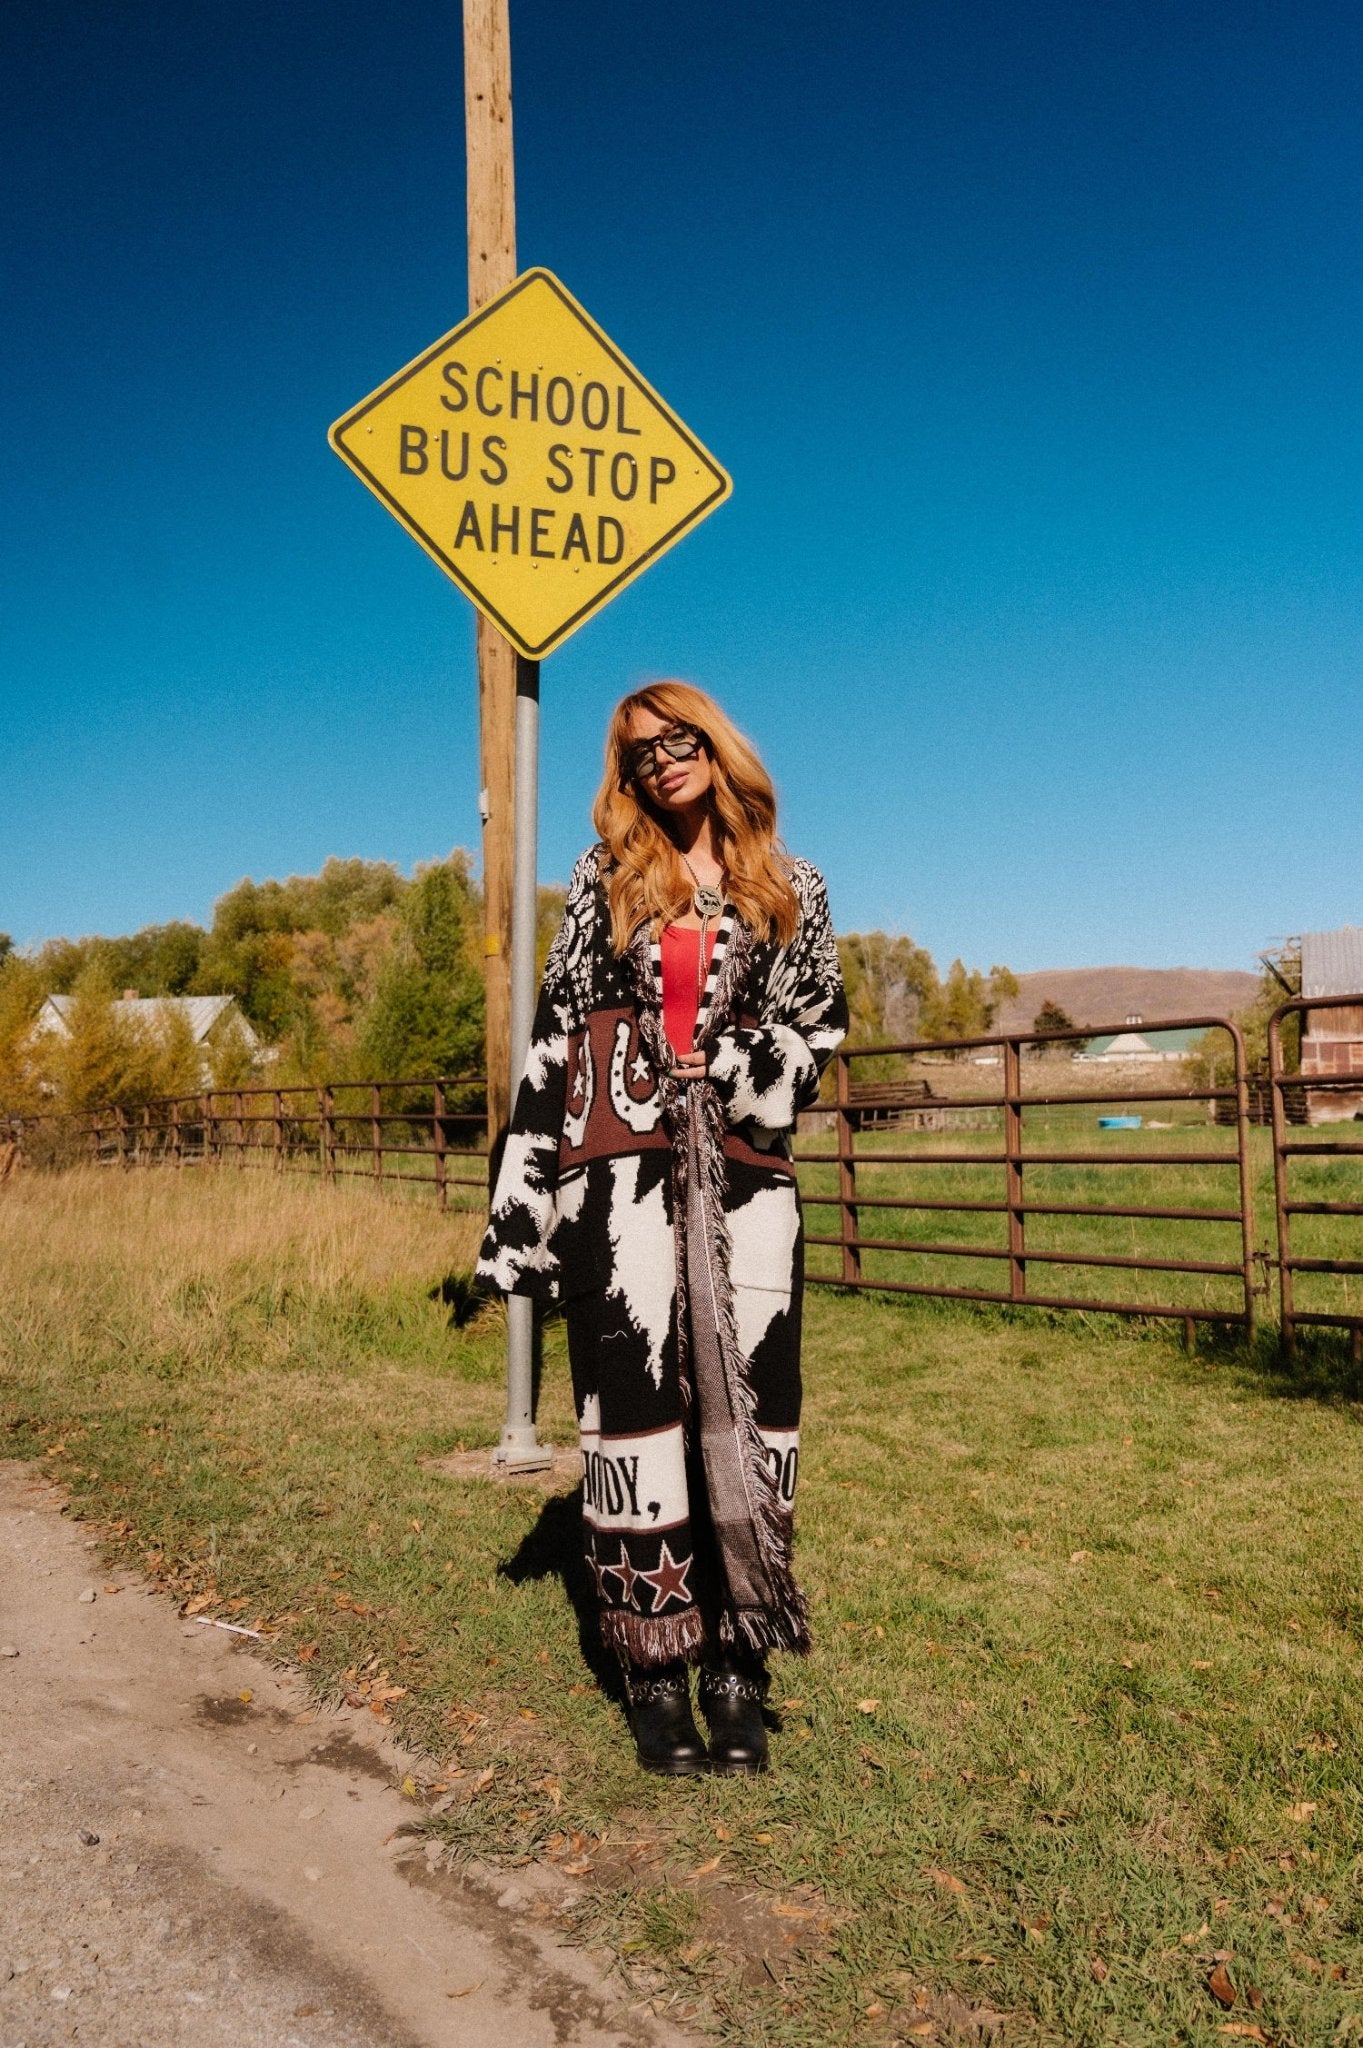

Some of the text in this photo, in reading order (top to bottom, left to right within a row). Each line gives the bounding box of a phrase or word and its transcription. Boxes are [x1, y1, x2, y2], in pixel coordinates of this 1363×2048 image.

[440, 361, 641, 437] SCHOOL
[399, 424, 677, 505] BUS STOP
[453, 500, 626, 566] AHEAD
